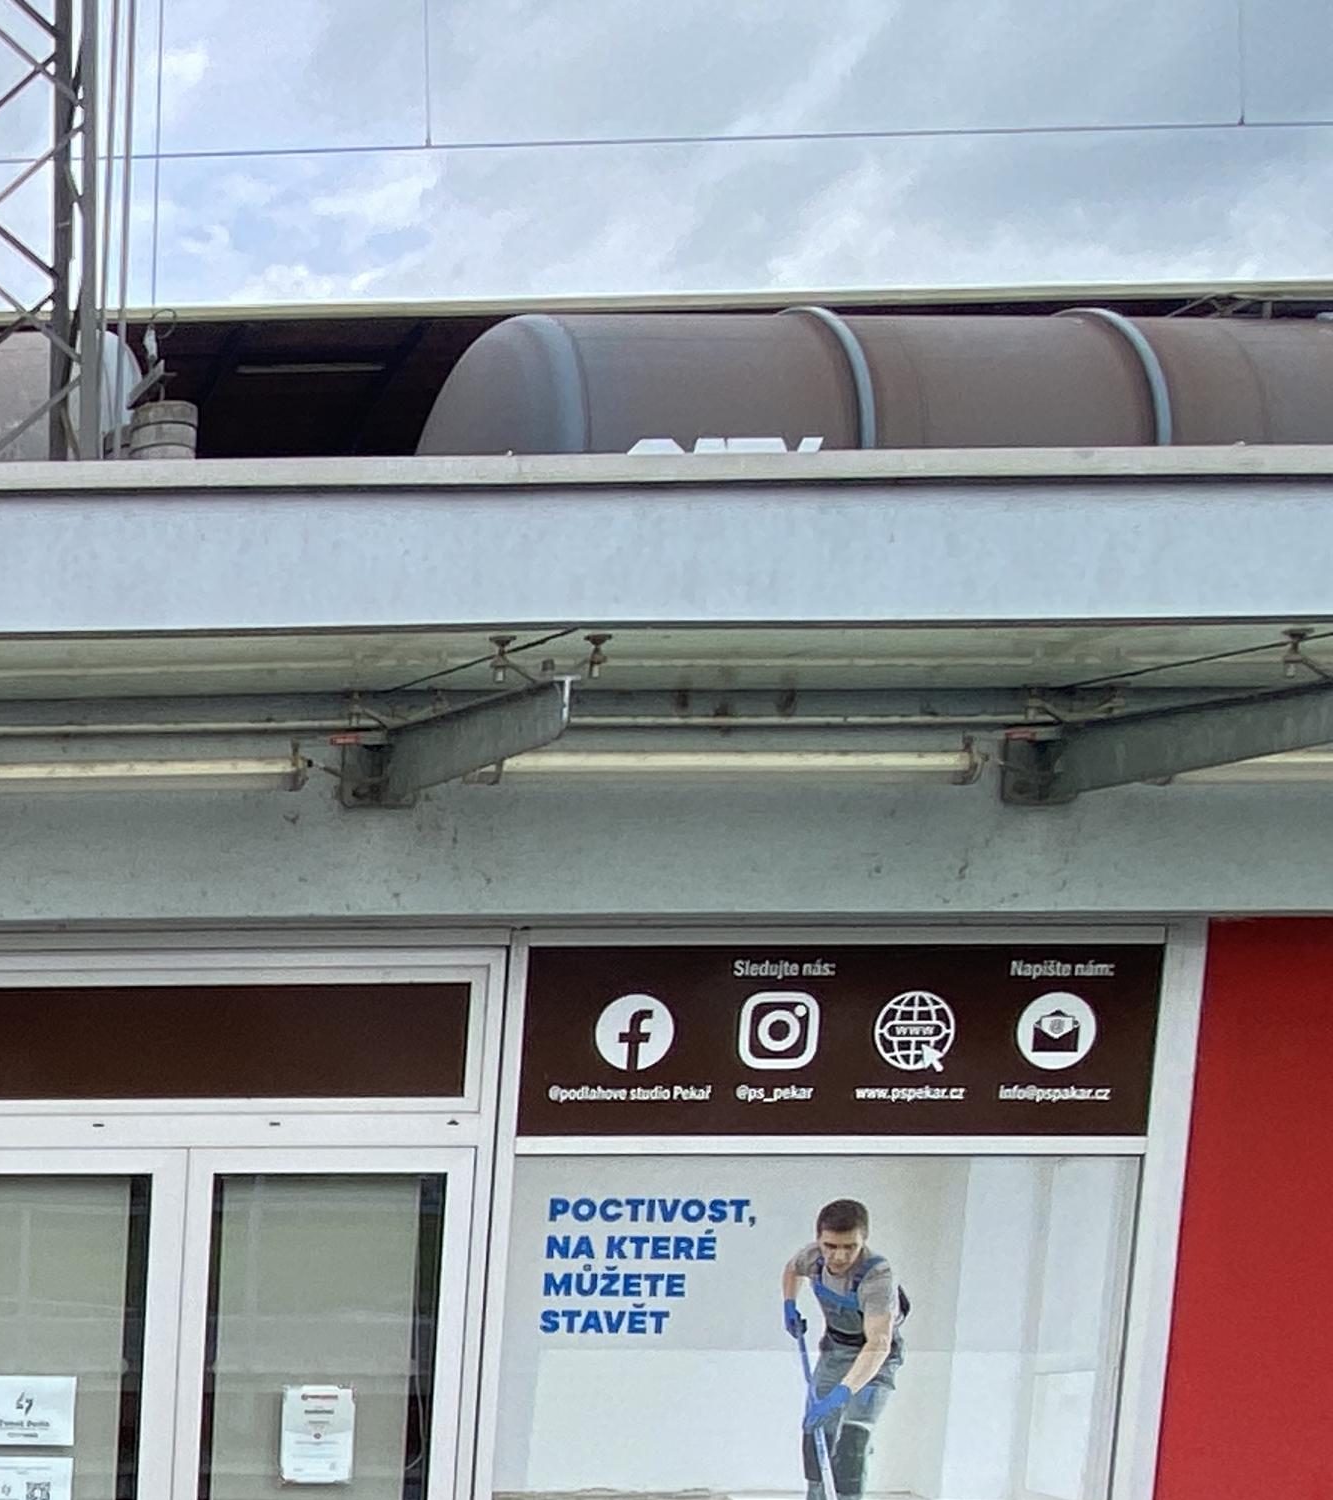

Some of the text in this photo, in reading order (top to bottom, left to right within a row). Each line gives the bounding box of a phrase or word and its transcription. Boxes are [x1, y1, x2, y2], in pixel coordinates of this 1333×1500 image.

[733, 958, 836, 979] Sledujte nás:
[1010, 960, 1115, 979] Napište nám:
[629, 1085, 670, 1101] studio
[736, 1085, 814, 1103] @ps_pekar
[855, 1085, 965, 1102] www.pspekar.cz
[548, 1197, 756, 1228] POCTIVOST,
[545, 1228, 717, 1261] NA KTERÉ
[542, 1264, 686, 1298] MŮŽETE
[539, 1302, 670, 1334] STAVĚT
